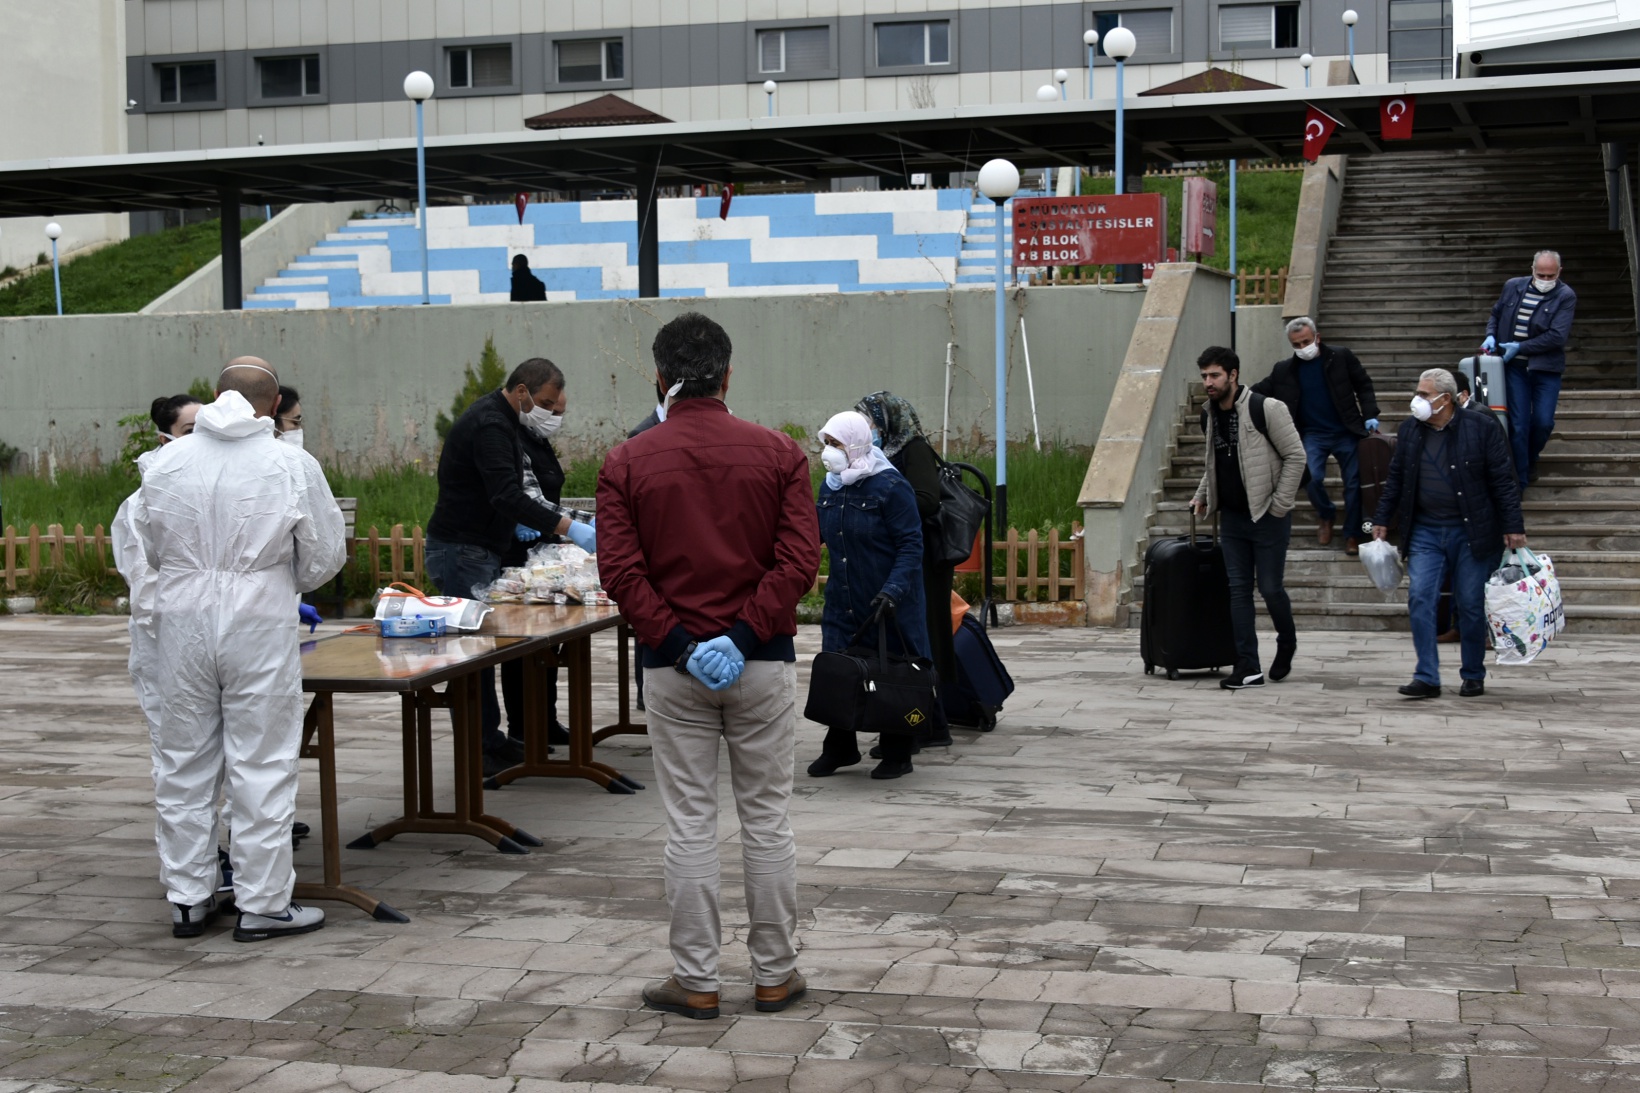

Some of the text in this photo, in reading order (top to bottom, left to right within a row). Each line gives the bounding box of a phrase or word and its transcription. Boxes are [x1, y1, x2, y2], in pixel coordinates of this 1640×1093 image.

[1030, 202, 1107, 216] MÜDÜRLÜK
[1030, 217, 1154, 231] SOSYAL TESİSLER
[1030, 235, 1079, 246] A BLOK
[1030, 250, 1079, 261] B BLOK
